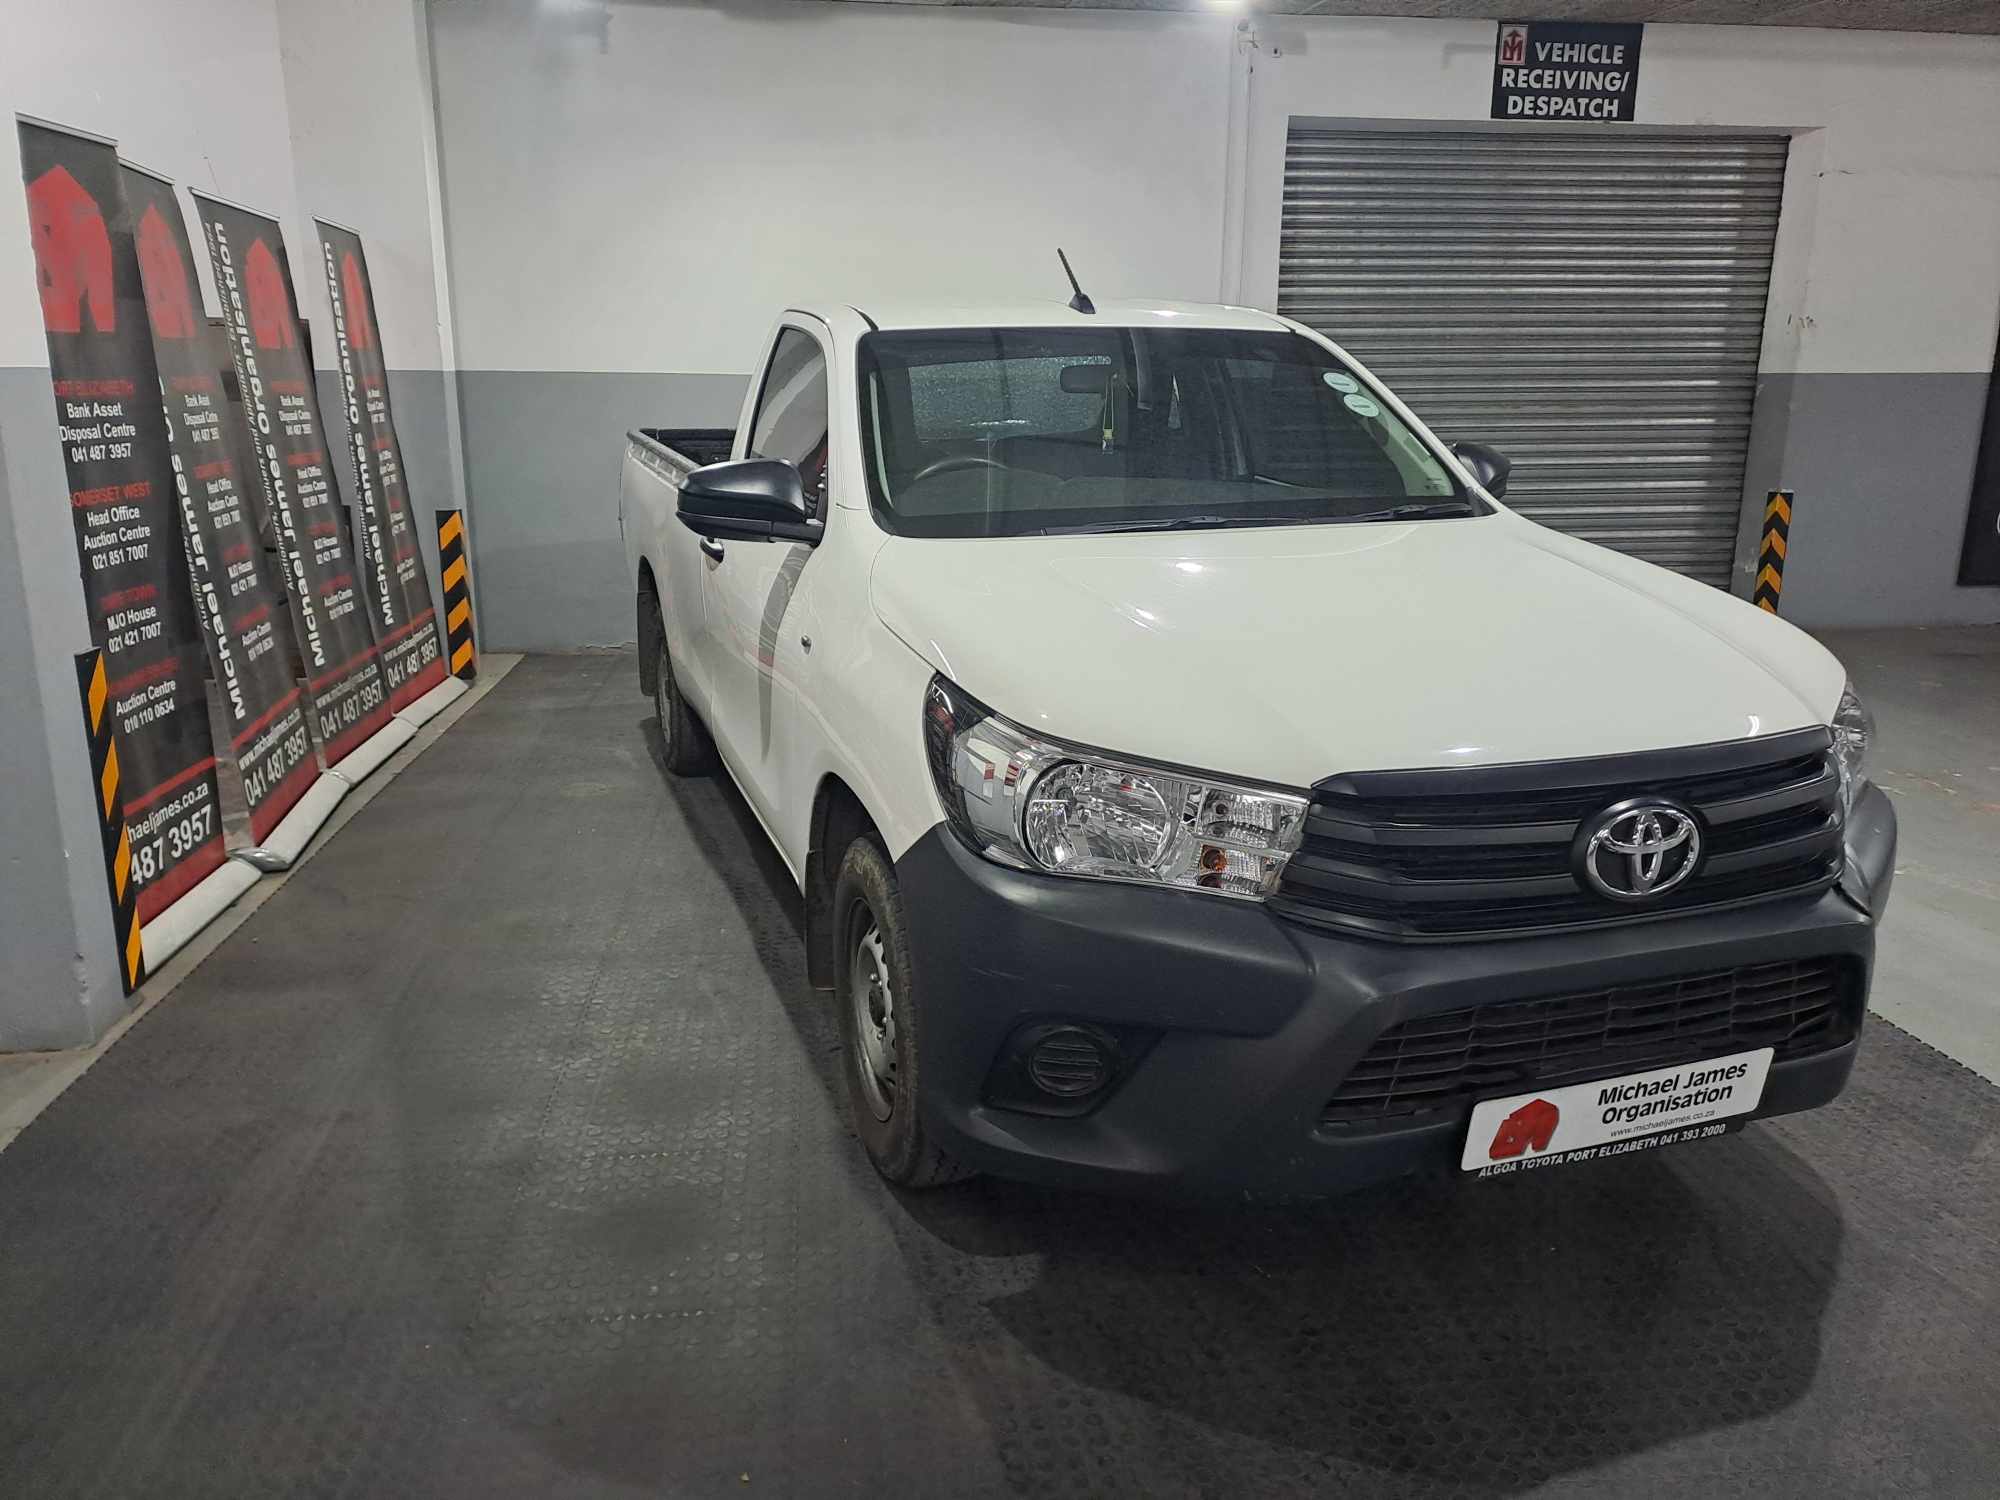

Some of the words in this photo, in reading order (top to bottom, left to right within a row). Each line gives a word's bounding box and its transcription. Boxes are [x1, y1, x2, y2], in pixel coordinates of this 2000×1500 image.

[1535, 42, 1625, 65] VEHICLE
[1501, 68, 1630, 92] RECEIVING/
[1507, 95, 1619, 118] DESPATCH
[215, 222, 270, 435] Organisation
[324, 241, 360, 425] Organisation
[66, 402, 91, 419] Bank
[93, 402, 123, 417] Asset
[60, 424, 101, 443] Disposal
[104, 422, 136, 438] Centre
[72, 447, 88, 463] 041
[90, 445, 106, 461] 487
[109, 443, 132, 459] 3957
[266, 444, 296, 542] James
[354, 432, 376, 518] James
[87, 510, 109, 527] Head
[111, 505, 140, 522] Office
[171, 454, 208, 572] James
[84, 530, 117, 550] Auction
[119, 525, 151, 543] Centre
[92, 554, 108, 571] 021
[108, 550, 125, 567] 851
[126, 544, 149, 562] 7007
[368, 525, 394, 626] Michael
[107, 613, 126, 632] MJO
[126, 605, 157, 625] House
[288, 550, 326, 667] Michael
[108, 637, 123, 654] 021
[124, 630, 139, 647] 421
[141, 622, 161, 640] 7007
[202, 582, 246, 720] Michael
[387, 660, 406, 689] 041
[116, 693, 147, 716] Auction
[148, 680, 176, 700] Centre
[321, 707, 342, 738] 041
[342, 694, 360, 723] 487
[360, 679, 382, 711] 3957
[244, 766, 267, 806] 041
[267, 747, 285, 783] 487
[284, 725, 307, 766] 3957
[127, 782, 209, 844] haeljames.co.za
[131, 837, 164, 885] 487
[169, 804, 211, 859] 3957
[1598, 1073, 1680, 1106] Michael
[1684, 1063, 1748, 1090] James
[1601, 1083, 1733, 1124] Organisation
[1478, 1161, 1518, 1178] ALGOA
[1520, 1154, 1564, 1170] TOYOTA
[1566, 1148, 1598, 1164] PORT
[1598, 1137, 1659, 1158] ELIZABETH
[1659, 1133, 1680, 1147] 041
[1681, 1128, 1701, 1143] 393
[1701, 1123, 1726, 1138] 2000
